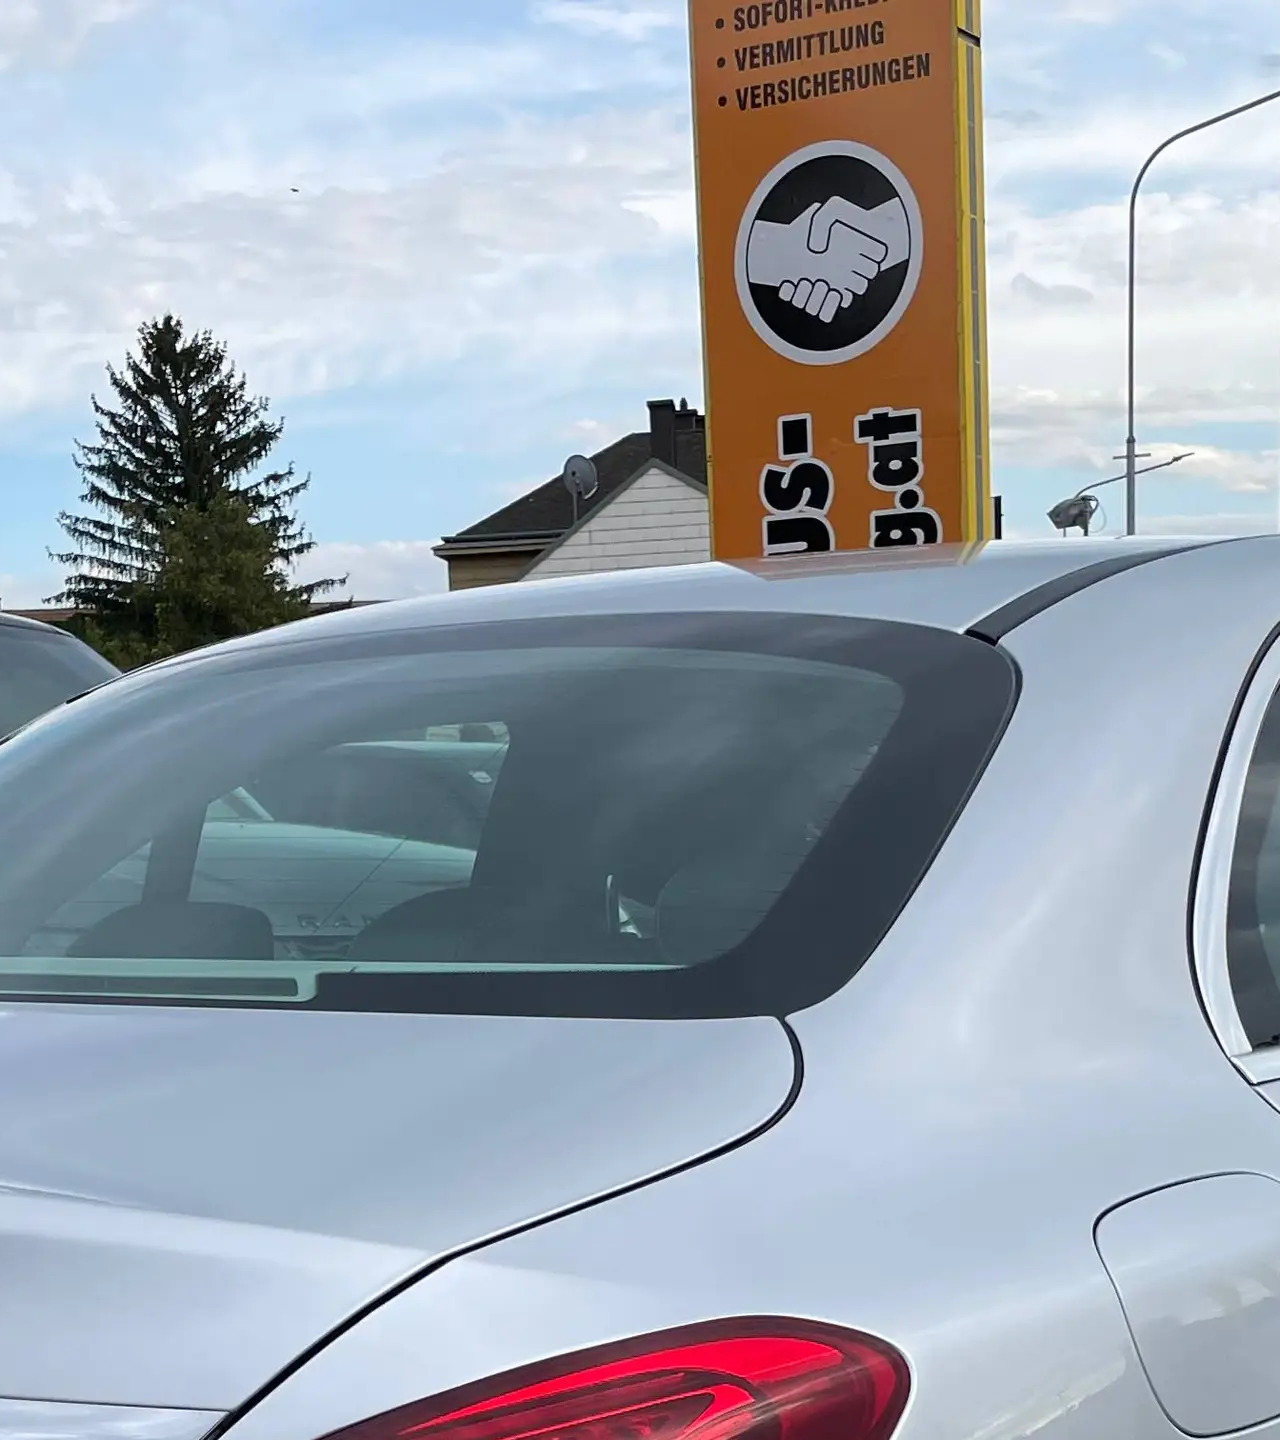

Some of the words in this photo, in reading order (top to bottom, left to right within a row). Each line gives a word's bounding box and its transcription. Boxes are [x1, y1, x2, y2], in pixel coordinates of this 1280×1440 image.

[735, 21, 884, 71] VERMITTLUNG
[735, 53, 930, 111] VERSICHERUNGEN
[854, 407, 942, 549] g.at
